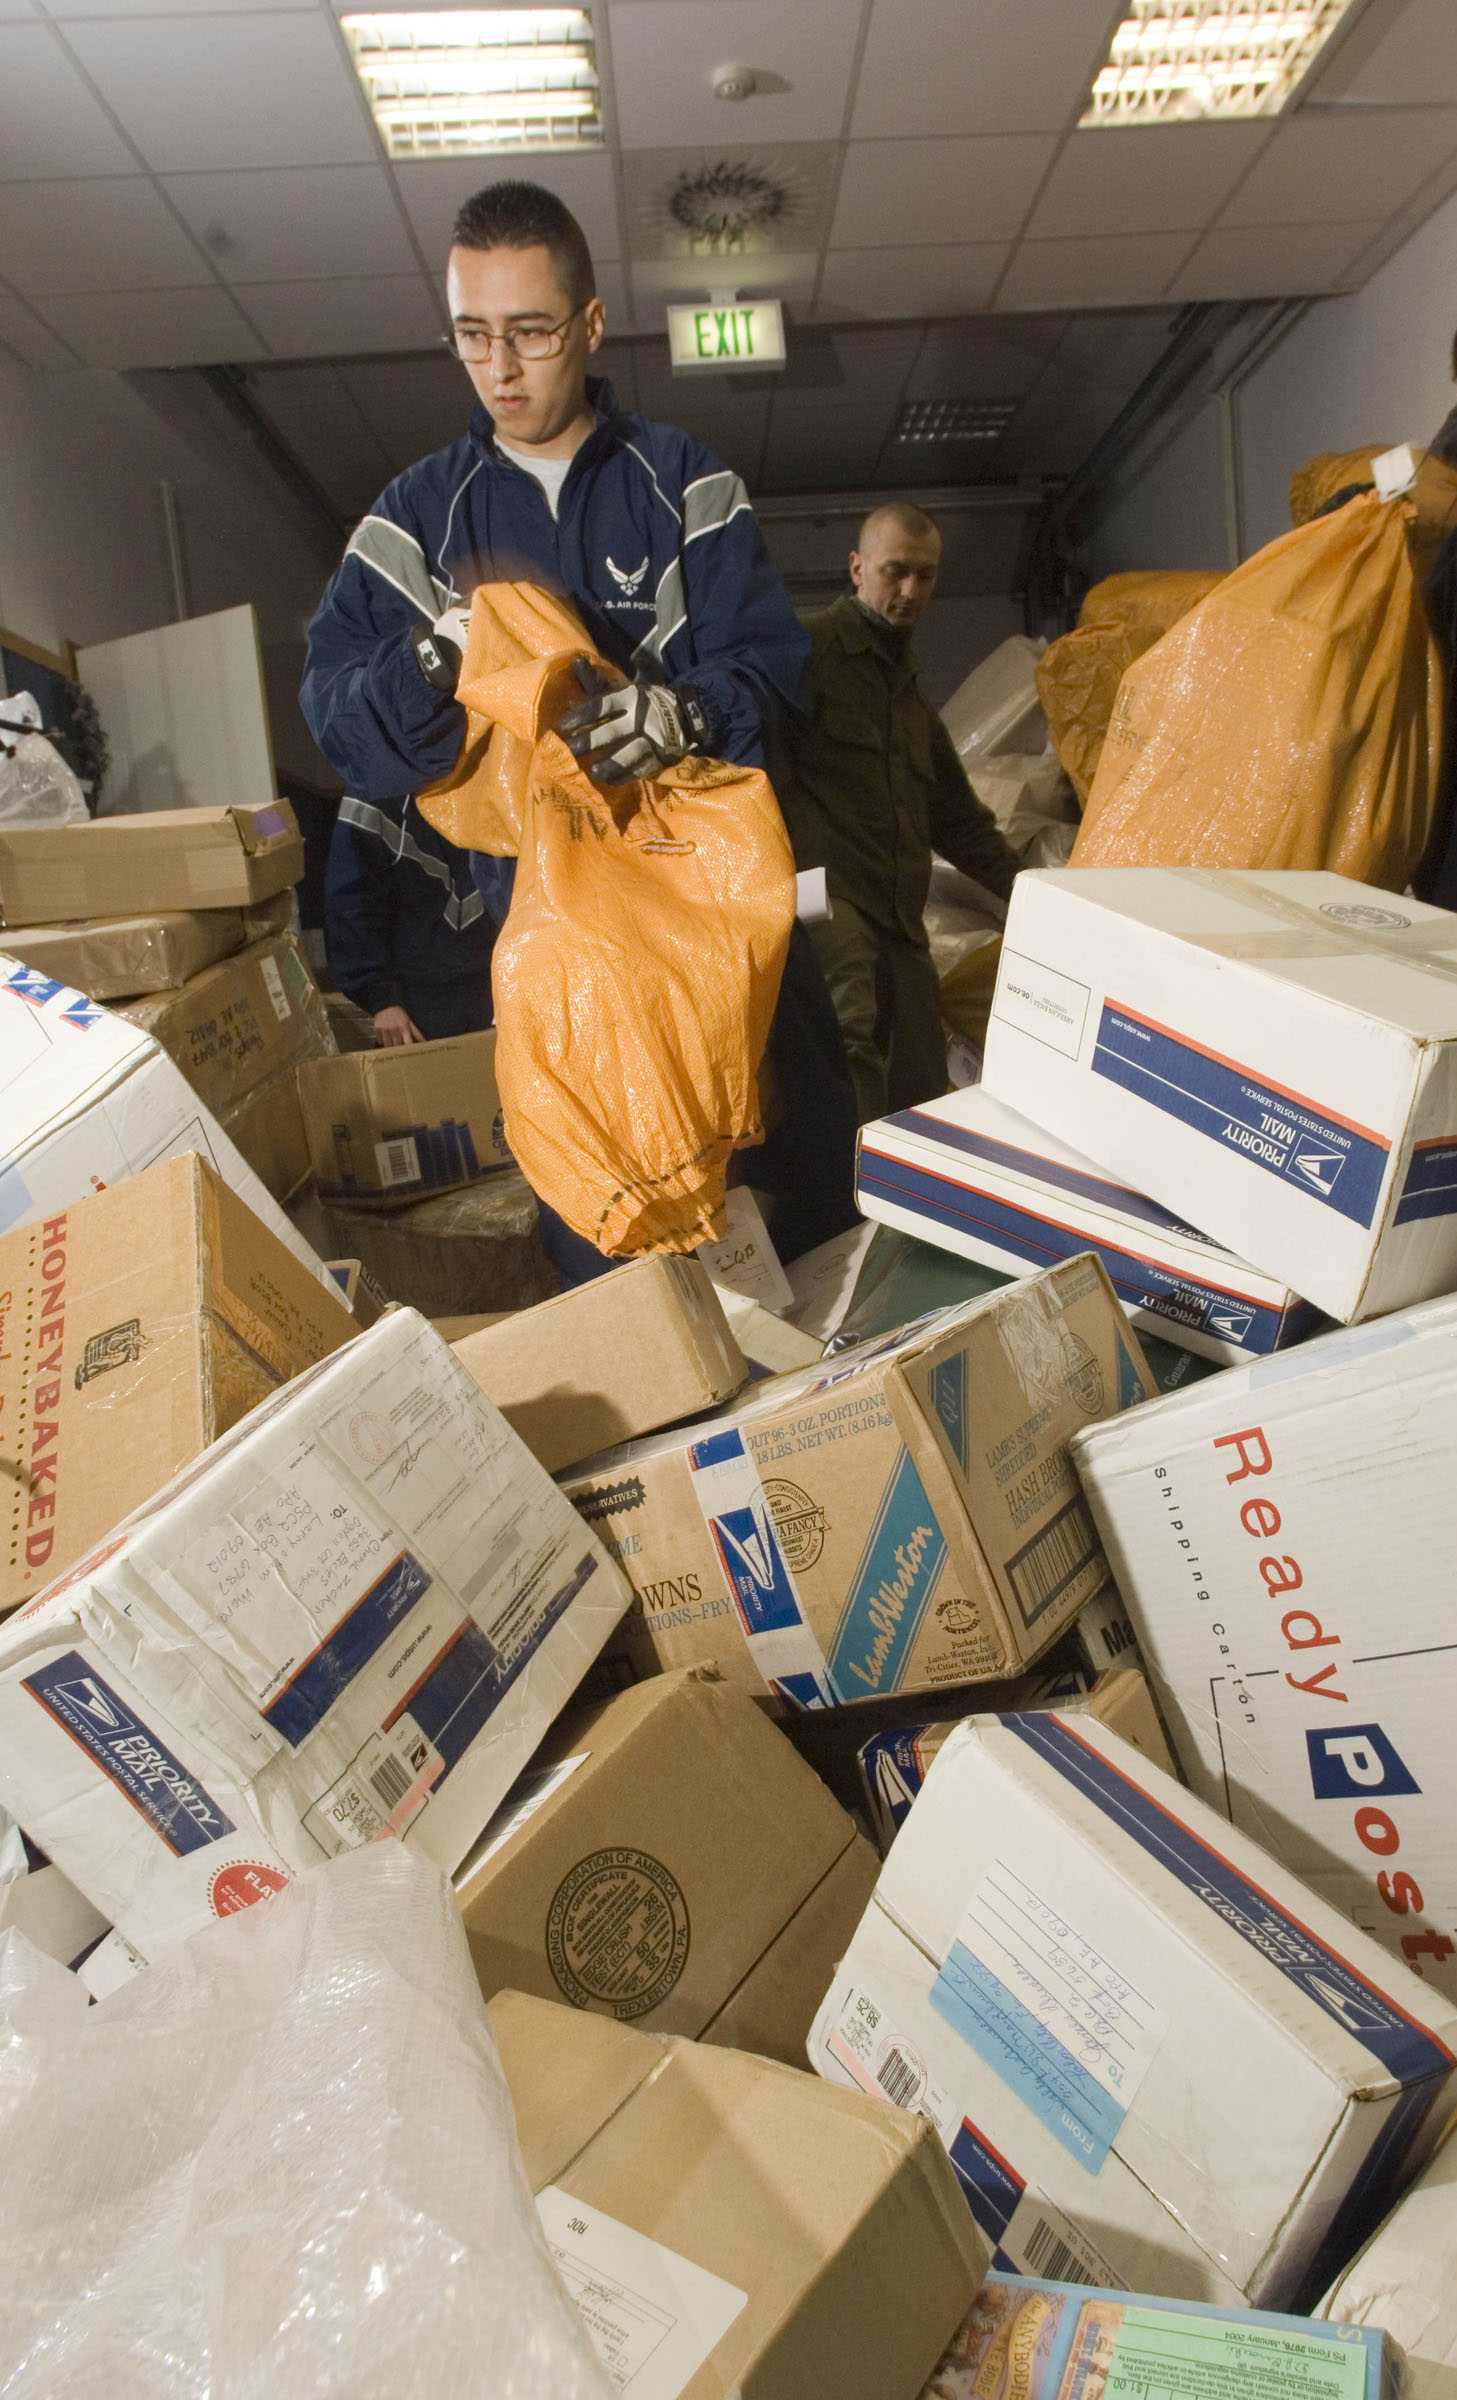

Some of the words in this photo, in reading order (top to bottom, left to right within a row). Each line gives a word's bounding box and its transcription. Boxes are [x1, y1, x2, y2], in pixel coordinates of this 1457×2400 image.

[694, 309, 754, 357] EXIT
[617, 601, 631, 609] AIR
[1110, 1016, 1151, 1042] www.usps.com
[1244, 1086, 1273, 1107] SERVICE
[1271, 1100, 1299, 1120] POSTAL
[1255, 1111, 1297, 1144] MAIL
[1297, 1113, 1324, 1133] STATES
[1322, 1127, 1351, 1148] UNITED
[1220, 1120, 1287, 1168] PRIORITY
[1152, 1271, 1180, 1286] SERVICE
[1178, 1281, 1205, 1296] POSTAL
[1137, 1293, 1200, 1326] PRIORITY
[1170, 1287, 1208, 1310] MAIL
[1204, 1290, 1230, 1305] STATES
[1229, 1299, 1256, 1314] UNITED
[797, 1415, 817, 1432] OZ.
[819, 1392, 885, 1426] PORTIONS
[756, 1450, 768, 1464] 18
[769, 1442, 794, 1459] LBS.
[797, 1431, 824, 1451] NET
[824, 1424, 847, 1441] WT.
[847, 1414, 875, 1436] (8.16
[992, 1441, 1038, 1487] SHREDDED
[1002, 1470, 1043, 1516] HASH
[327, 1503, 347, 1521] TO:
[787, 1516, 817, 1534] FANCY
[738, 1576, 748, 1595] MAIL
[745, 1575, 763, 1613] PRIORITY
[1154, 1467, 1210, 1601] Shipping
[1212, 1622, 1255, 1725] Carton
[386, 1622, 433, 1679] www.usps.com
[951, 1636, 977, 1649] Packed
[978, 1634, 990, 1643] for
[929, 1670, 967, 1684] PRODUCT
[967, 1668, 979, 1676] OF
[961, 1657, 973, 1666] WA
[42, 1687, 79, 1725] UNITED
[75, 1723, 108, 1756] STATES
[105, 1754, 141, 1793] POSTAL
[137, 1790, 173, 1830] SERVICE
[107, 1738, 162, 1792] MAIL
[127, 1734, 220, 1822] PRIORITY
[616, 1852, 632, 1863] OF
[551, 1852, 613, 1926] CORPORATION
[635, 1854, 678, 1901] AMERICA
[566, 1914, 575, 1942] BOX
[572, 1871, 627, 1911] CERTIFICATE
[575, 1882, 620, 1931] SINGLEWALL
[1191, 1883, 1297, 1962] PRIORITY
[1247, 1891, 1288, 1927] SERVICE
[581, 1952, 608, 1982] EDGE
[603, 1922, 634, 1957] CRUSH
[641, 1891, 660, 1911] 26
[633, 1940, 652, 1959] 50
[1258, 1915, 1315, 1966] MAIL
[1289, 1927, 1327, 1961] POSTAL
[550, 1930, 589, 2006] PACKAGING
[588, 1963, 613, 1989] TEST
[607, 1939, 633, 1968] (ECT)
[643, 1952, 662, 1971] 35
[1325, 1958, 1364, 1993] STATES
[1362, 1990, 1404, 2028] UNITED
[1104, 2062, 1127, 2089] To
[1057, 2112, 1097, 2156] From
[970, 2142, 1016, 2195] www.usps.com
[566, 2215, 589, 2236] ROC
[1223, 2330, 1246, 2342] 2004
[1246, 2333, 1280, 2349] January
[1306, 2345, 1330, 2358] Form
[1331, 2349, 1346, 2361] PS
[1112, 2377, 1143, 2393] $1.00
